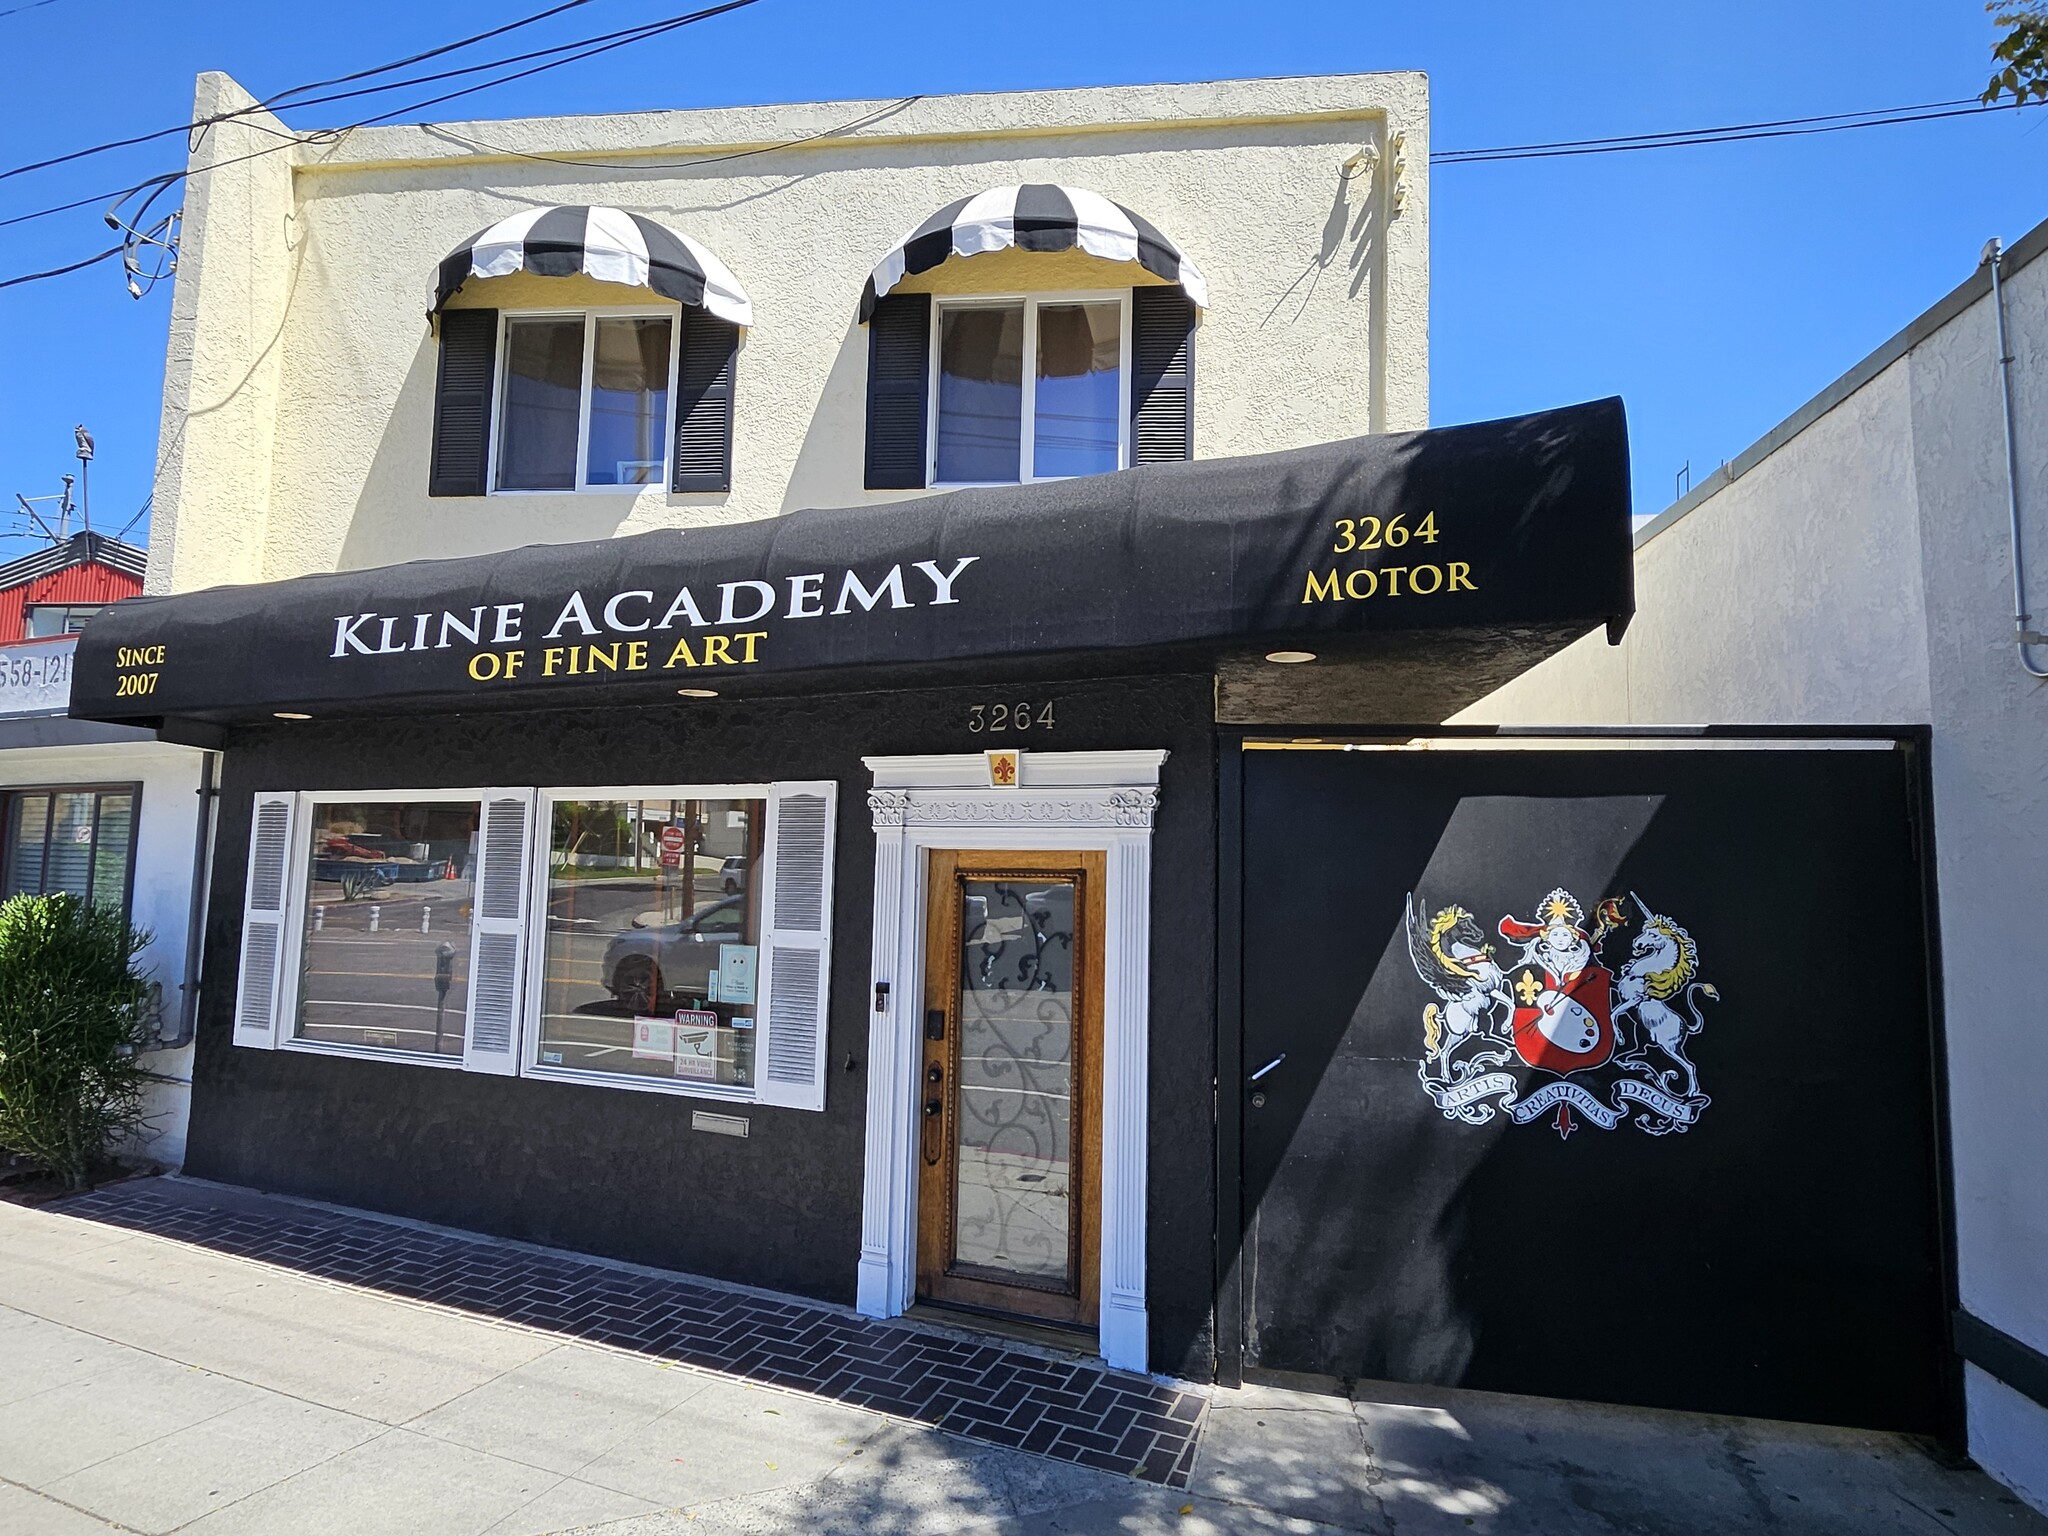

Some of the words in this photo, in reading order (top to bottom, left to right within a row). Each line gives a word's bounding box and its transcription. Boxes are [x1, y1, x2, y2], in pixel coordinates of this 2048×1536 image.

[1334, 510, 1440, 553] 3264
[1301, 561, 1480, 605] MOTOR
[329, 602, 524, 659] KLINE
[542, 556, 981, 639] ACADEMY
[115, 645, 166, 668] SINCE
[468, 650, 525, 681] OF
[541, 641, 648, 677] FINE
[664, 631, 768, 668] ART
[115, 672, 159, 697] 2007
[968, 700, 1056, 733] 3264
[678, 1012, 715, 1027] WARNING
[680, 1058, 687, 1066] 24
[1443, 1075, 1506, 1107] ARTIS
[1515, 1084, 1611, 1124] CREATIVITAS
[1621, 1082, 1686, 1118] DECUS
